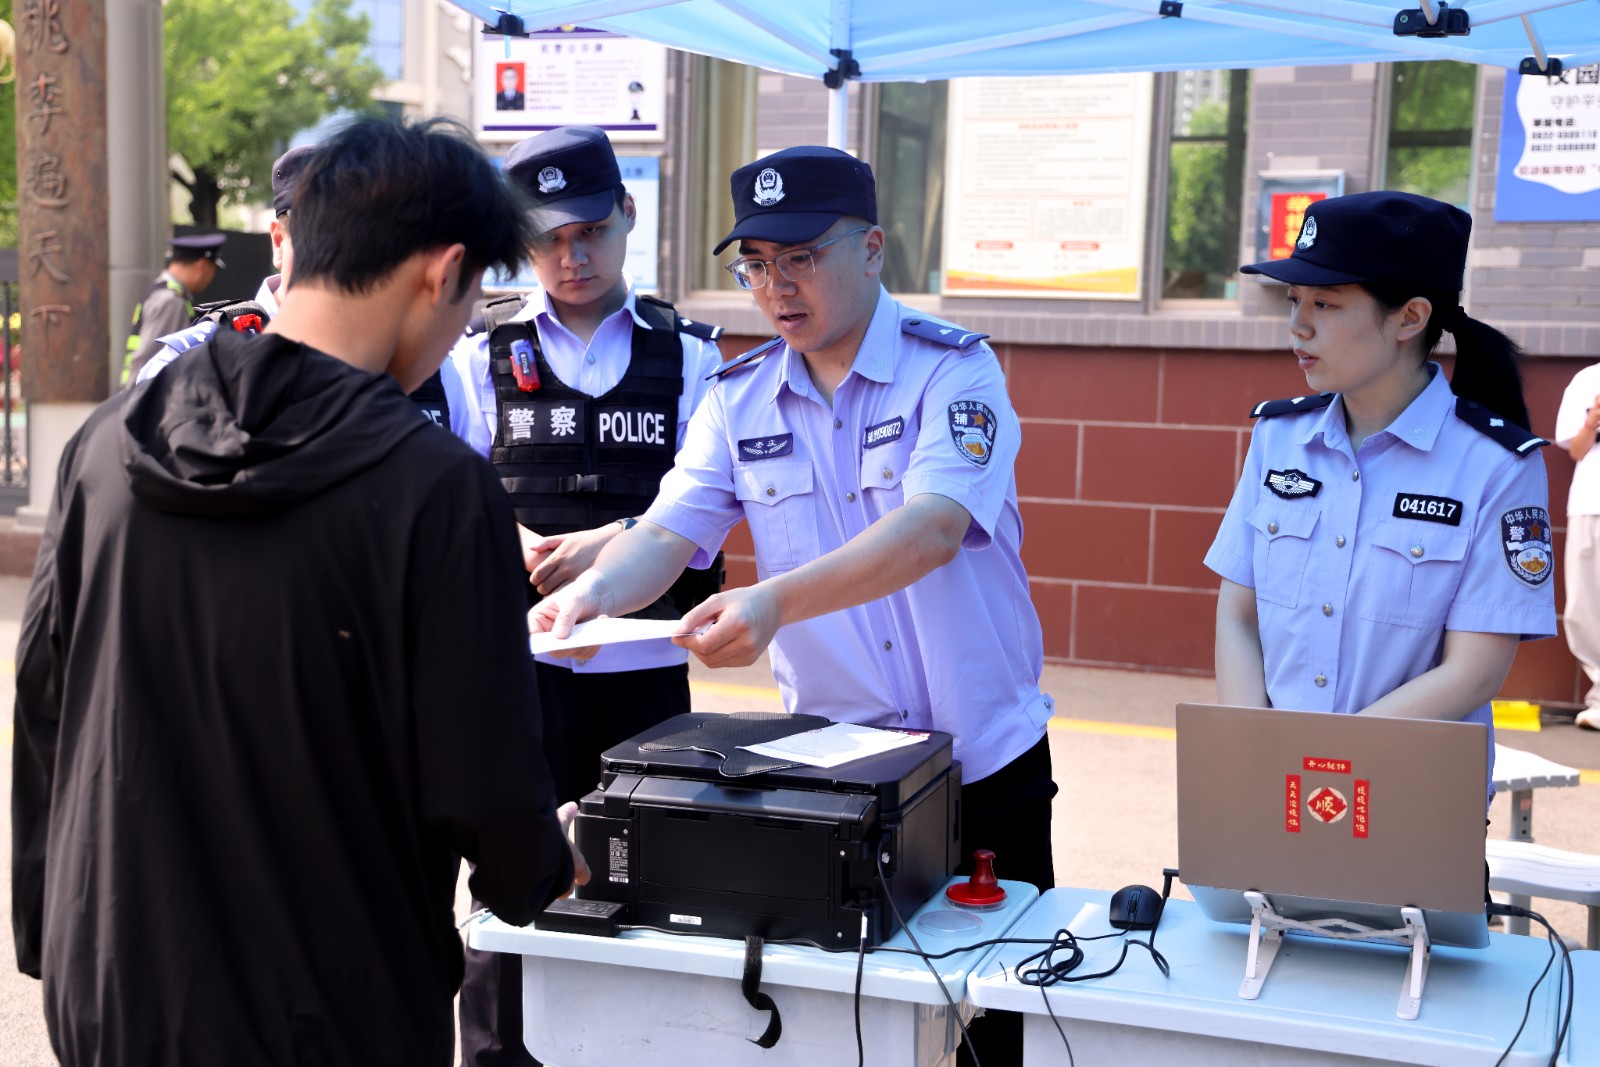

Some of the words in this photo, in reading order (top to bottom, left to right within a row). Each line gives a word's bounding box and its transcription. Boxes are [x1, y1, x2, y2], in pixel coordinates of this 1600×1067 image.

[509, 405, 576, 440] 警察
[599, 411, 665, 445] POLICE
[1399, 498, 1457, 518] 041617
[1308, 760, 1345, 770] 开心就好
[1316, 796, 1337, 815] 顺
